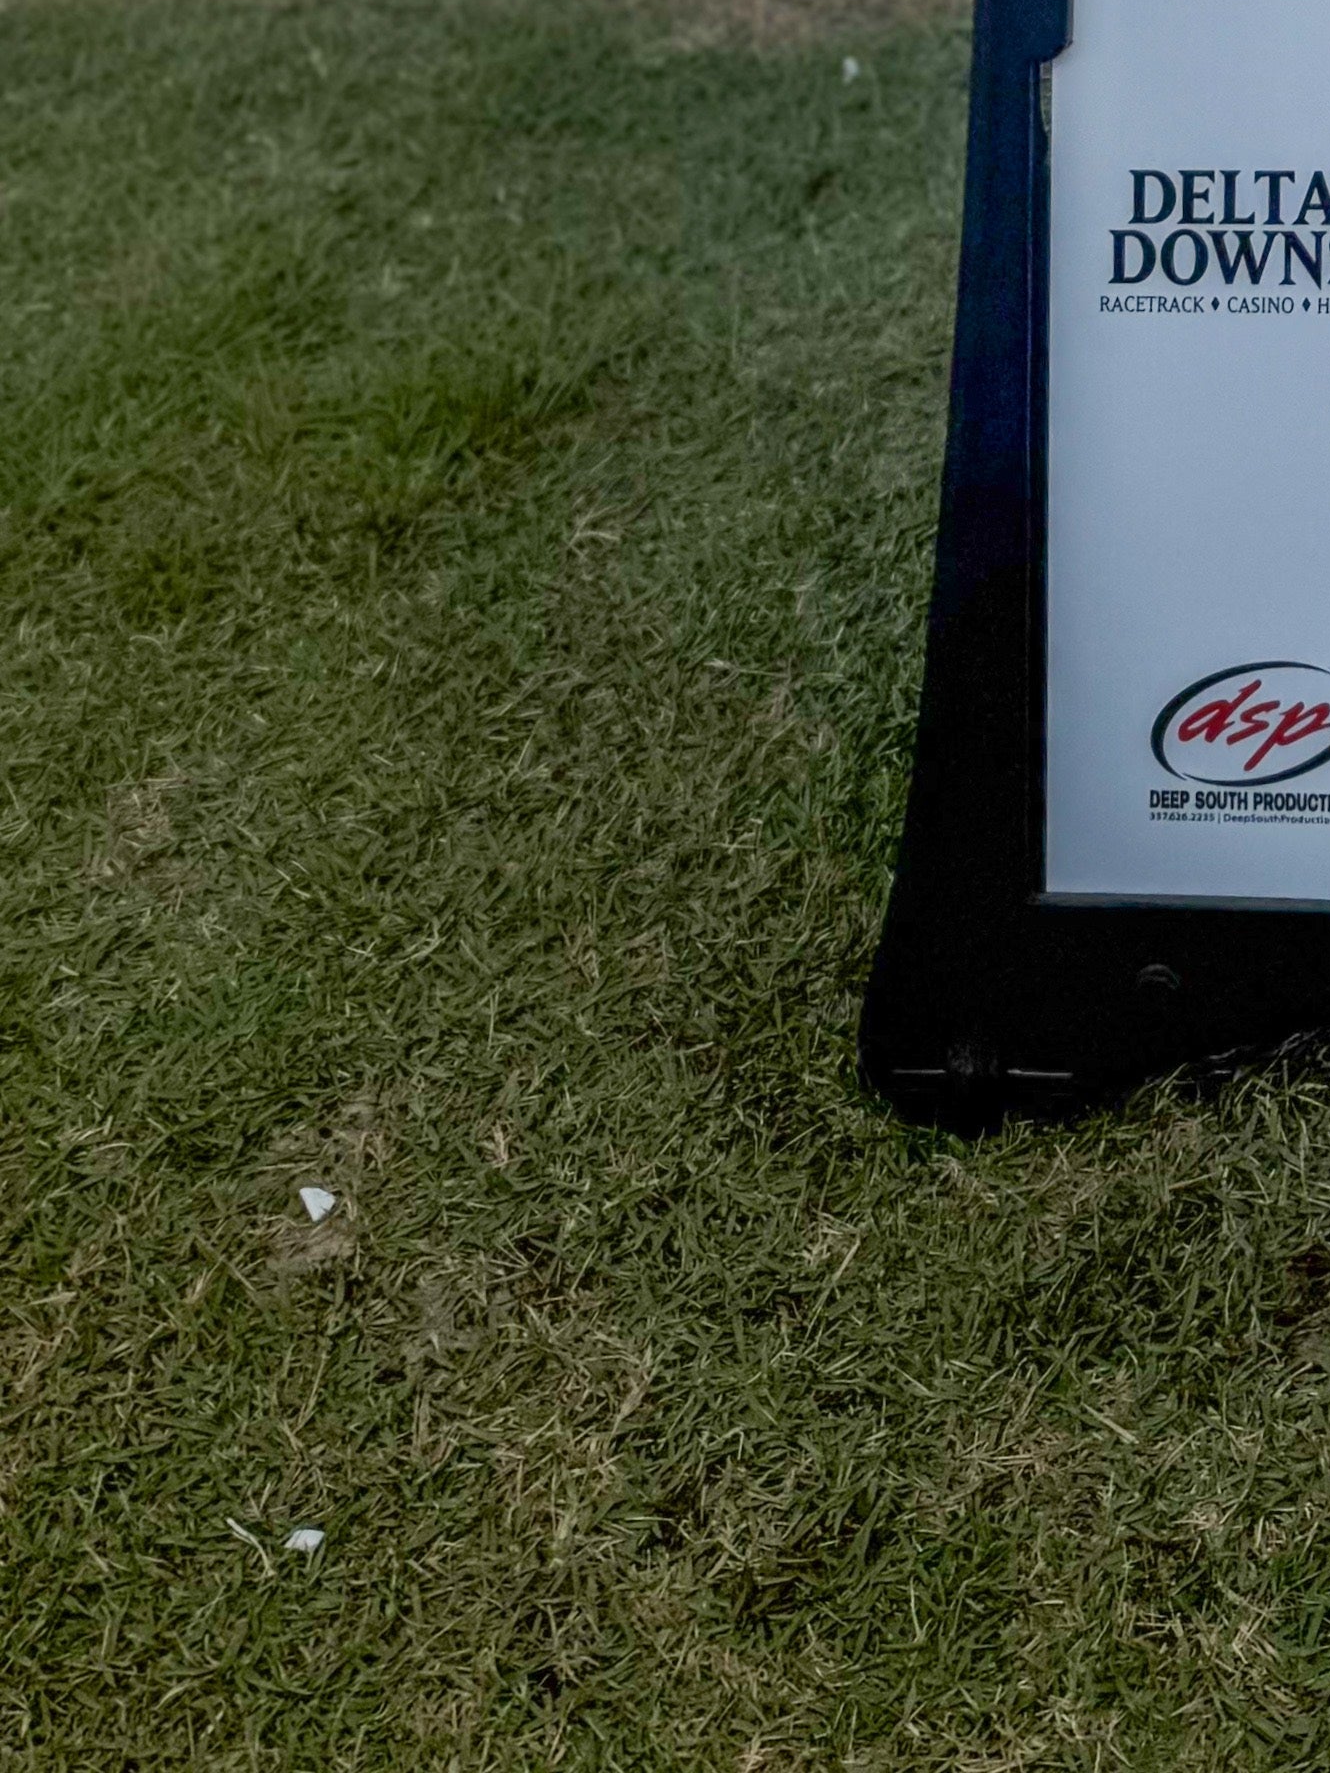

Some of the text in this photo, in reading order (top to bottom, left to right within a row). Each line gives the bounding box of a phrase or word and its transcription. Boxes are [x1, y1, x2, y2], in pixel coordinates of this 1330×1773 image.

[1100, 296, 1205, 314] RACETRACK
[1228, 297, 1296, 315] CASINO
[1150, 790, 1191, 809] DEEP
[1195, 791, 1249, 811] SOUTH
